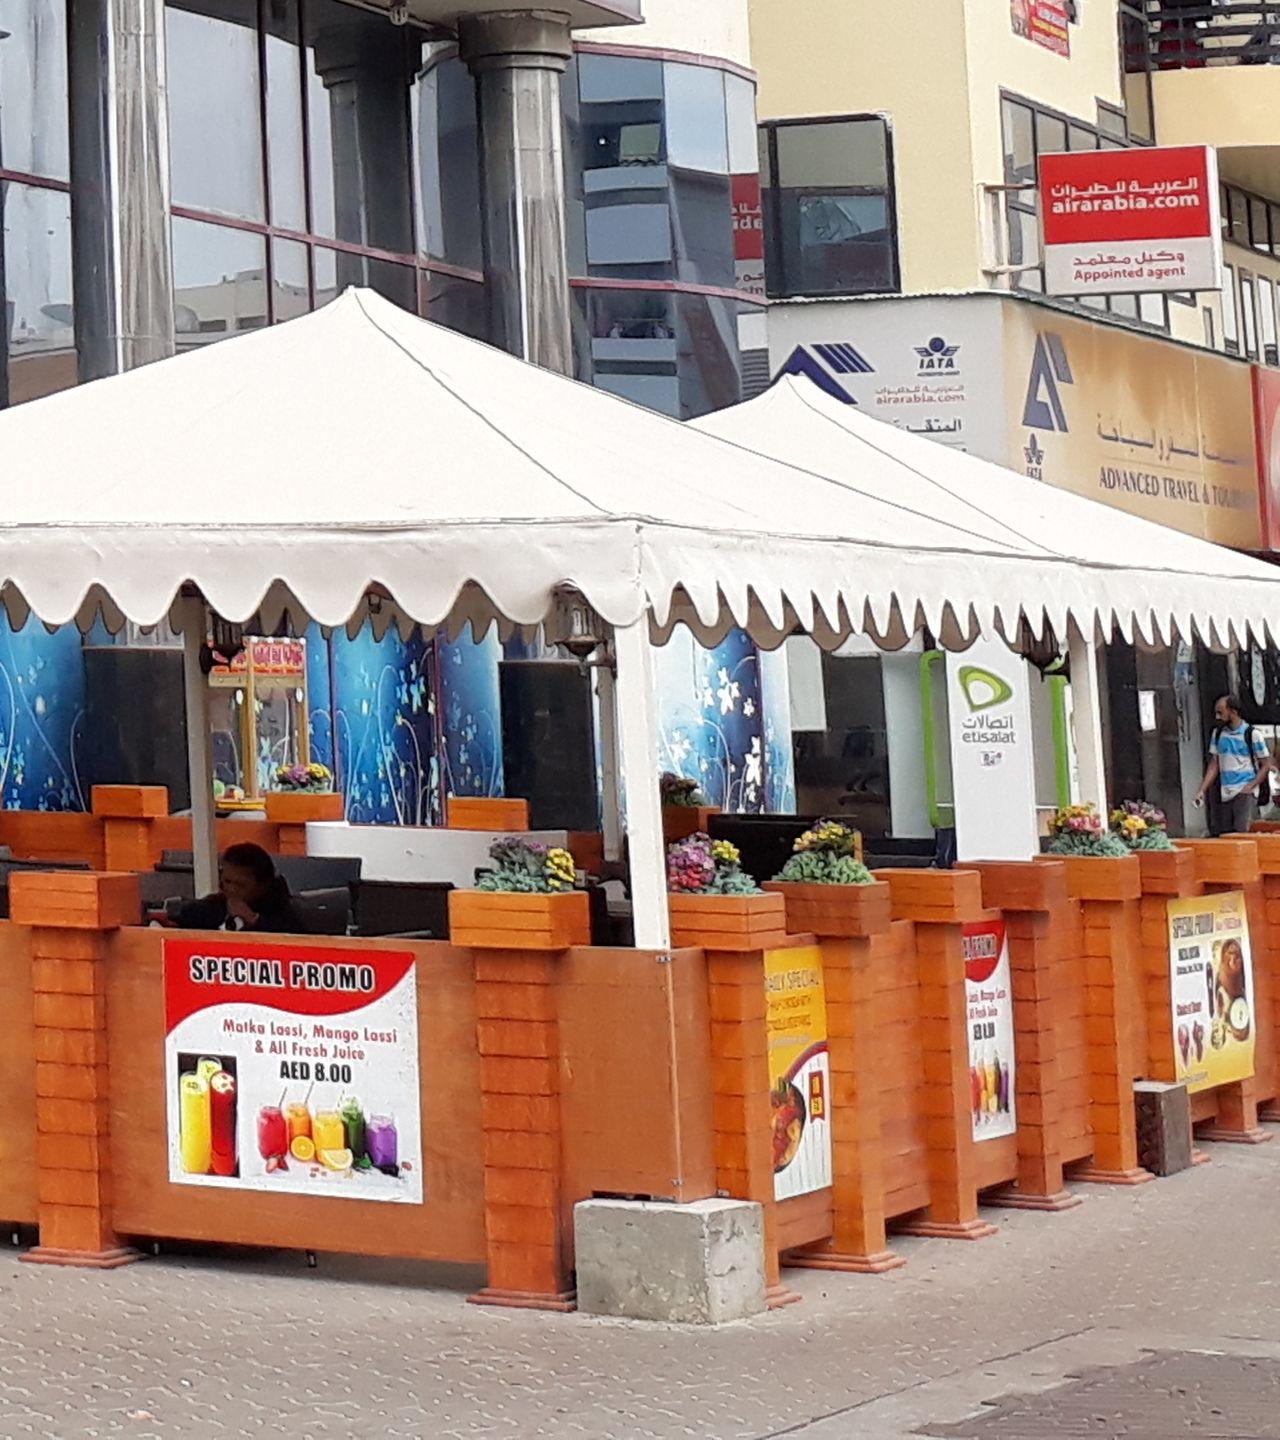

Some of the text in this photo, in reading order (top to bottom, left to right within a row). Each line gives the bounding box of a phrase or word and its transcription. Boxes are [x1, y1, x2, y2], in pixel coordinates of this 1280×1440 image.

[1052, 194, 1199, 214] airarabia.com
[1074, 266, 1185, 282] Appointed agent
[919, 357, 955, 369] IATA
[876, 393, 965, 405] airarabia.com
[1100, 467, 1160, 496] ADVANCED
[1163, 477, 1199, 503] TRAVEL
[962, 731, 1016, 744] etisalat
[191, 957, 375, 991] SPECIAL PROMO
[223, 1019, 398, 1043] Matka Lassi, Mango Lassi
[255, 1040, 365, 1061] & All Fresh Juice
[280, 1062, 352, 1084] AED 8.00
